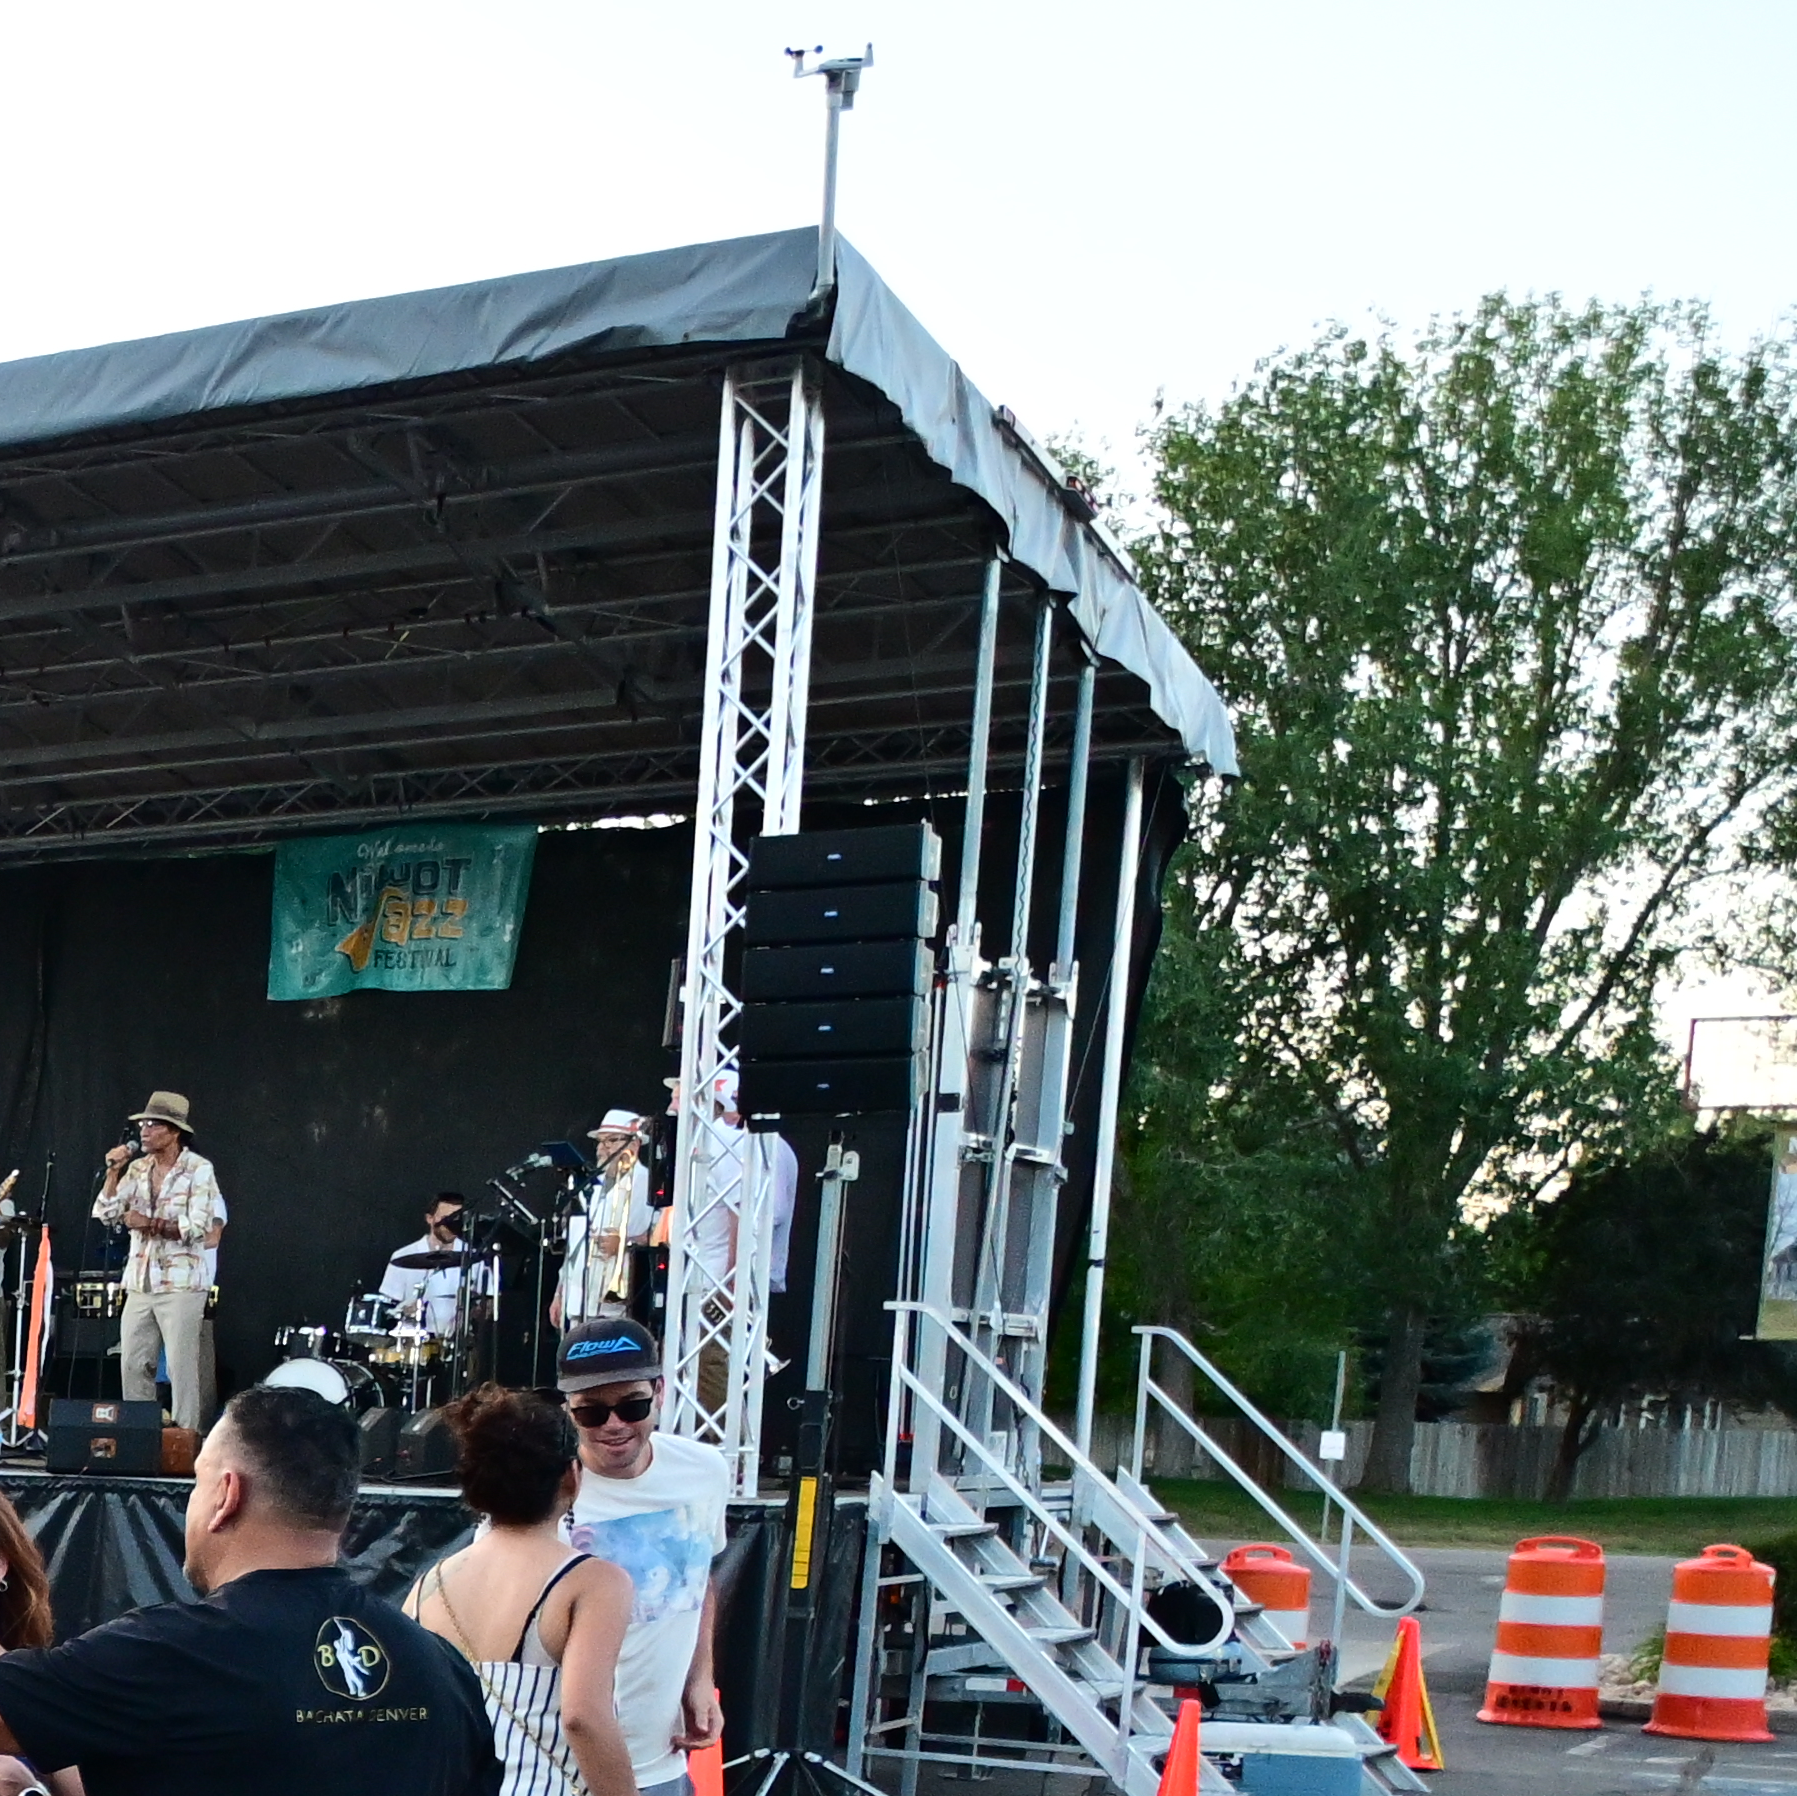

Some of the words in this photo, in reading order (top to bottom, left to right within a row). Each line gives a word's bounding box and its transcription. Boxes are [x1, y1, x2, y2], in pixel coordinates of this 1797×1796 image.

[373, 948, 457, 970] FESTIVAL
[317, 1644, 335, 1667] B
[357, 1645, 381, 1668] D
[295, 1709, 364, 1724] BACHATA
